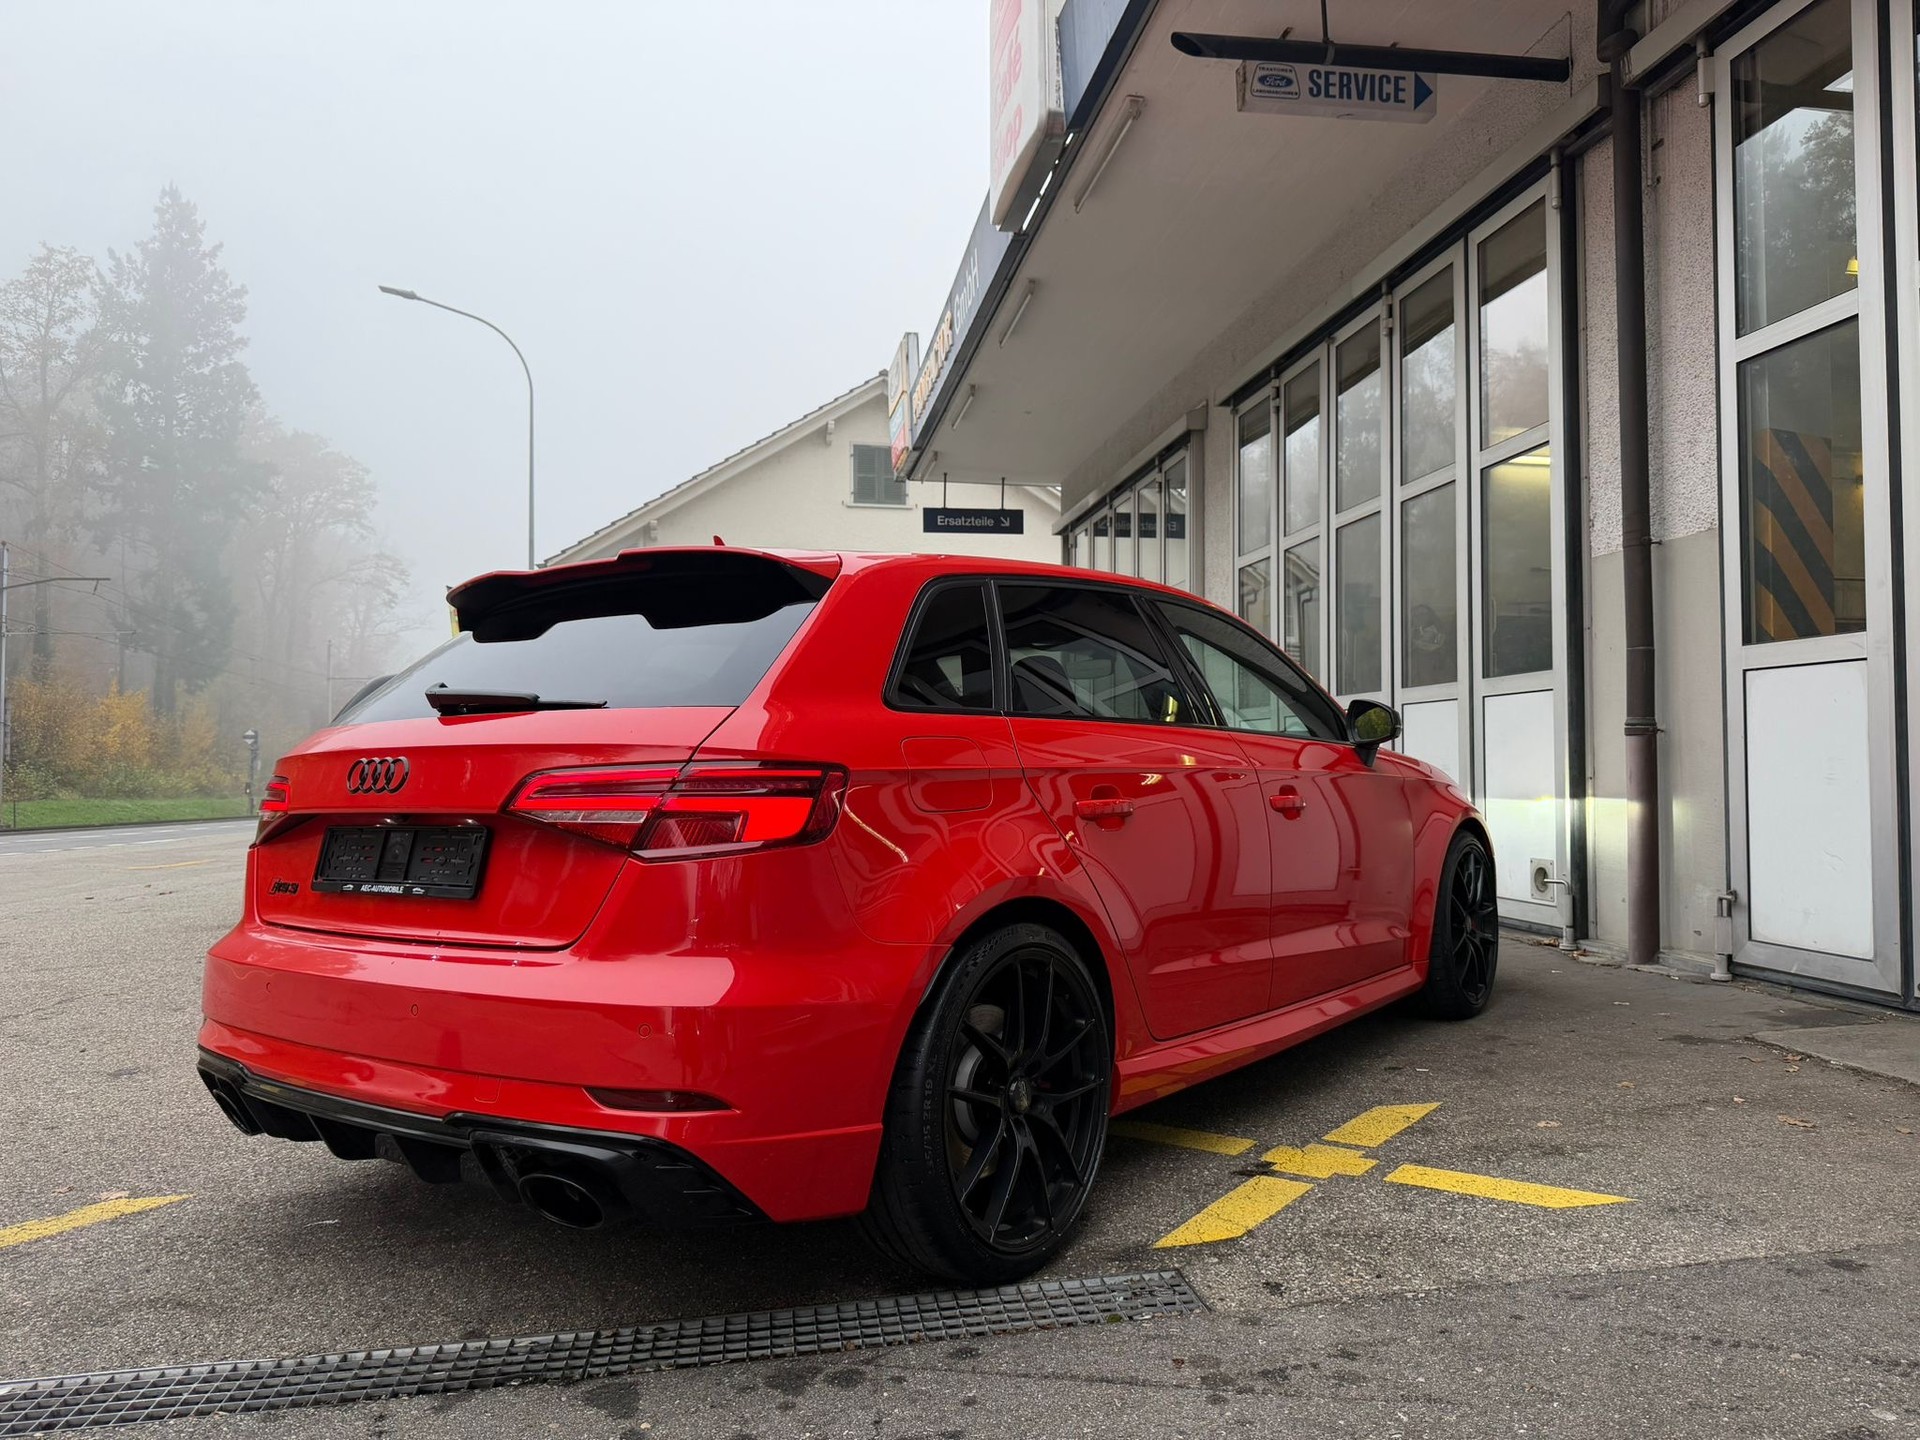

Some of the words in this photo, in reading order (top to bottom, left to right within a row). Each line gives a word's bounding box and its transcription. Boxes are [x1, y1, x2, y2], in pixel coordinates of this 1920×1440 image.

[1264, 76, 1288, 87] Ford
[1308, 69, 1406, 103] SERVICE
[953, 248, 979, 335] GmbH
[937, 515, 995, 527] Ersatzteile
[360, 884, 404, 894] AEC-AUTOMOBILE
